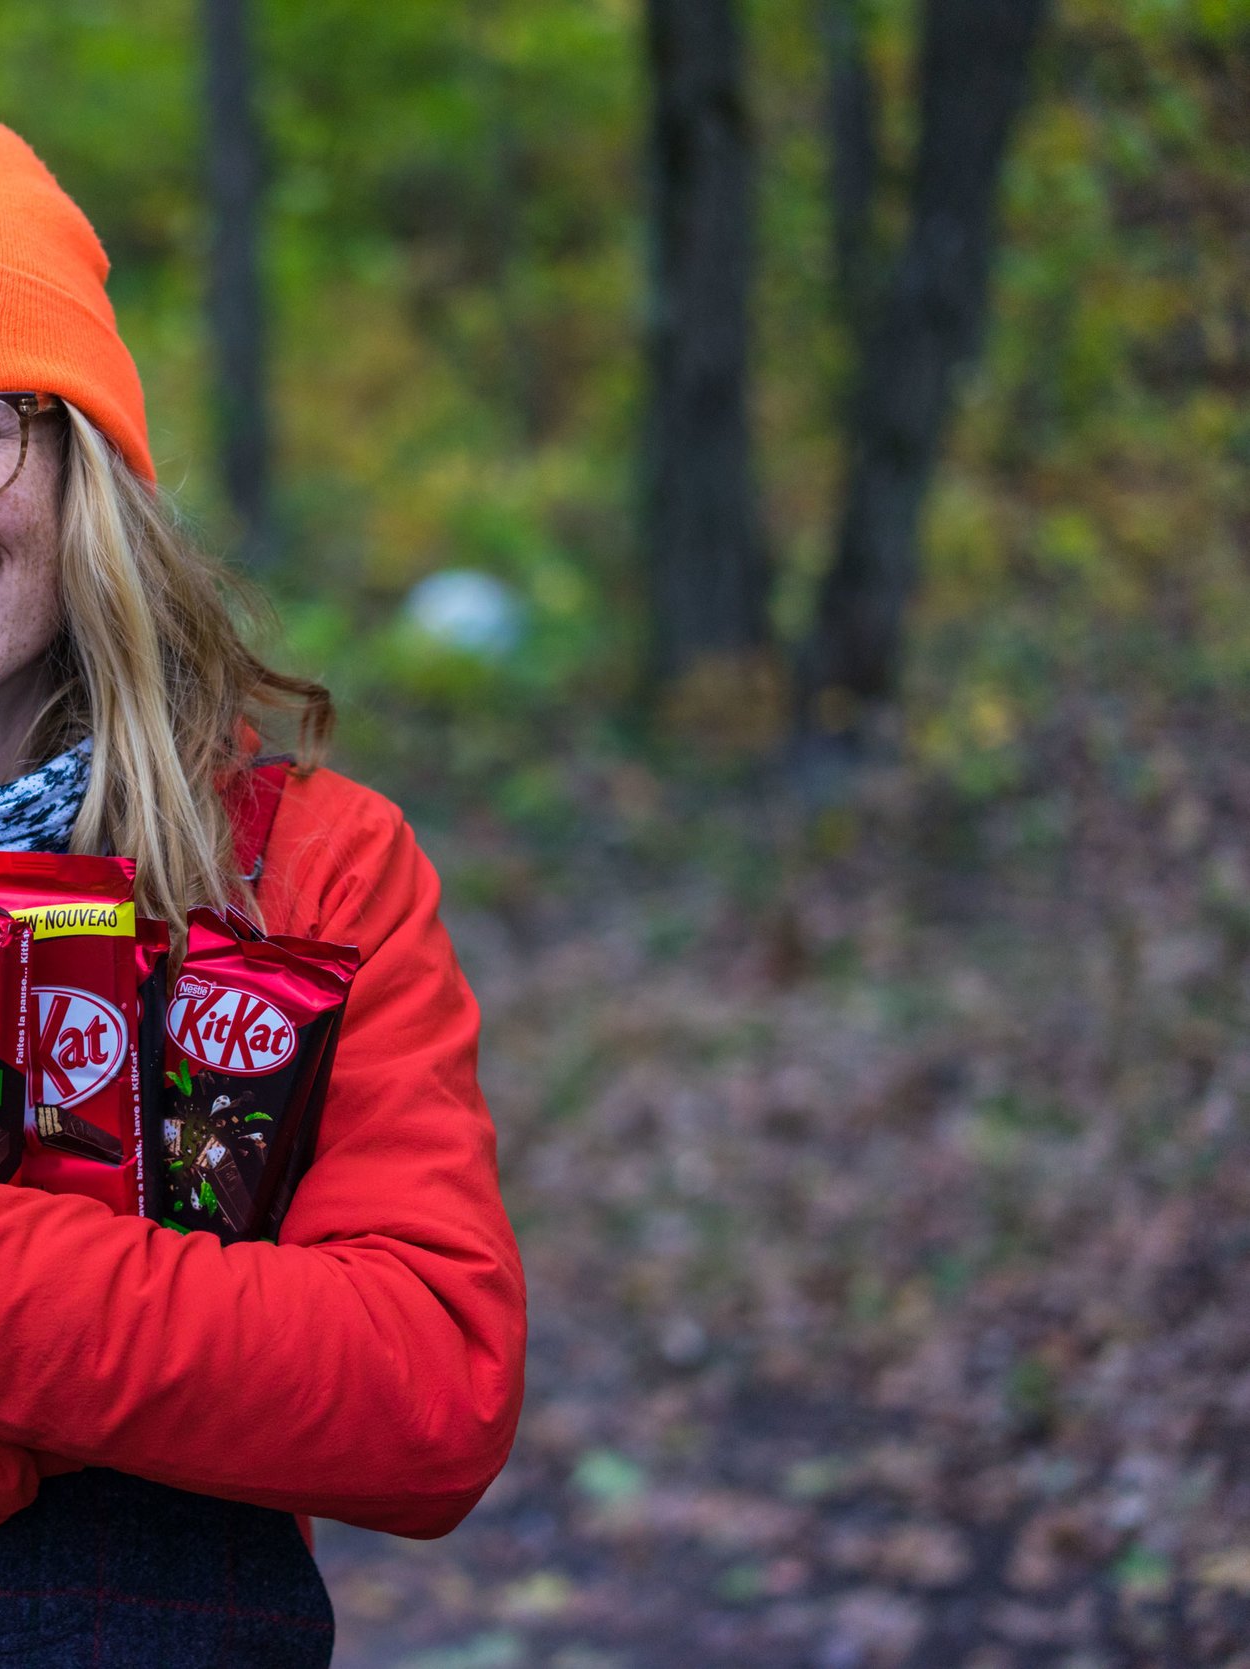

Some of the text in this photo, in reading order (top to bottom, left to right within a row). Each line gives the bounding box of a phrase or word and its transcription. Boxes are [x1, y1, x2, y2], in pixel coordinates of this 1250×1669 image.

[17, 1016, 26, 1027] la
[176, 989, 289, 1068] KitKat
[15, 1029, 25, 1064] Faites
[130, 1051, 139, 1091] KitKat
[132, 1093, 140, 1102] a
[133, 1105, 141, 1136] have
[137, 1183, 144, 1192] a
[137, 1195, 145, 1217] ave
